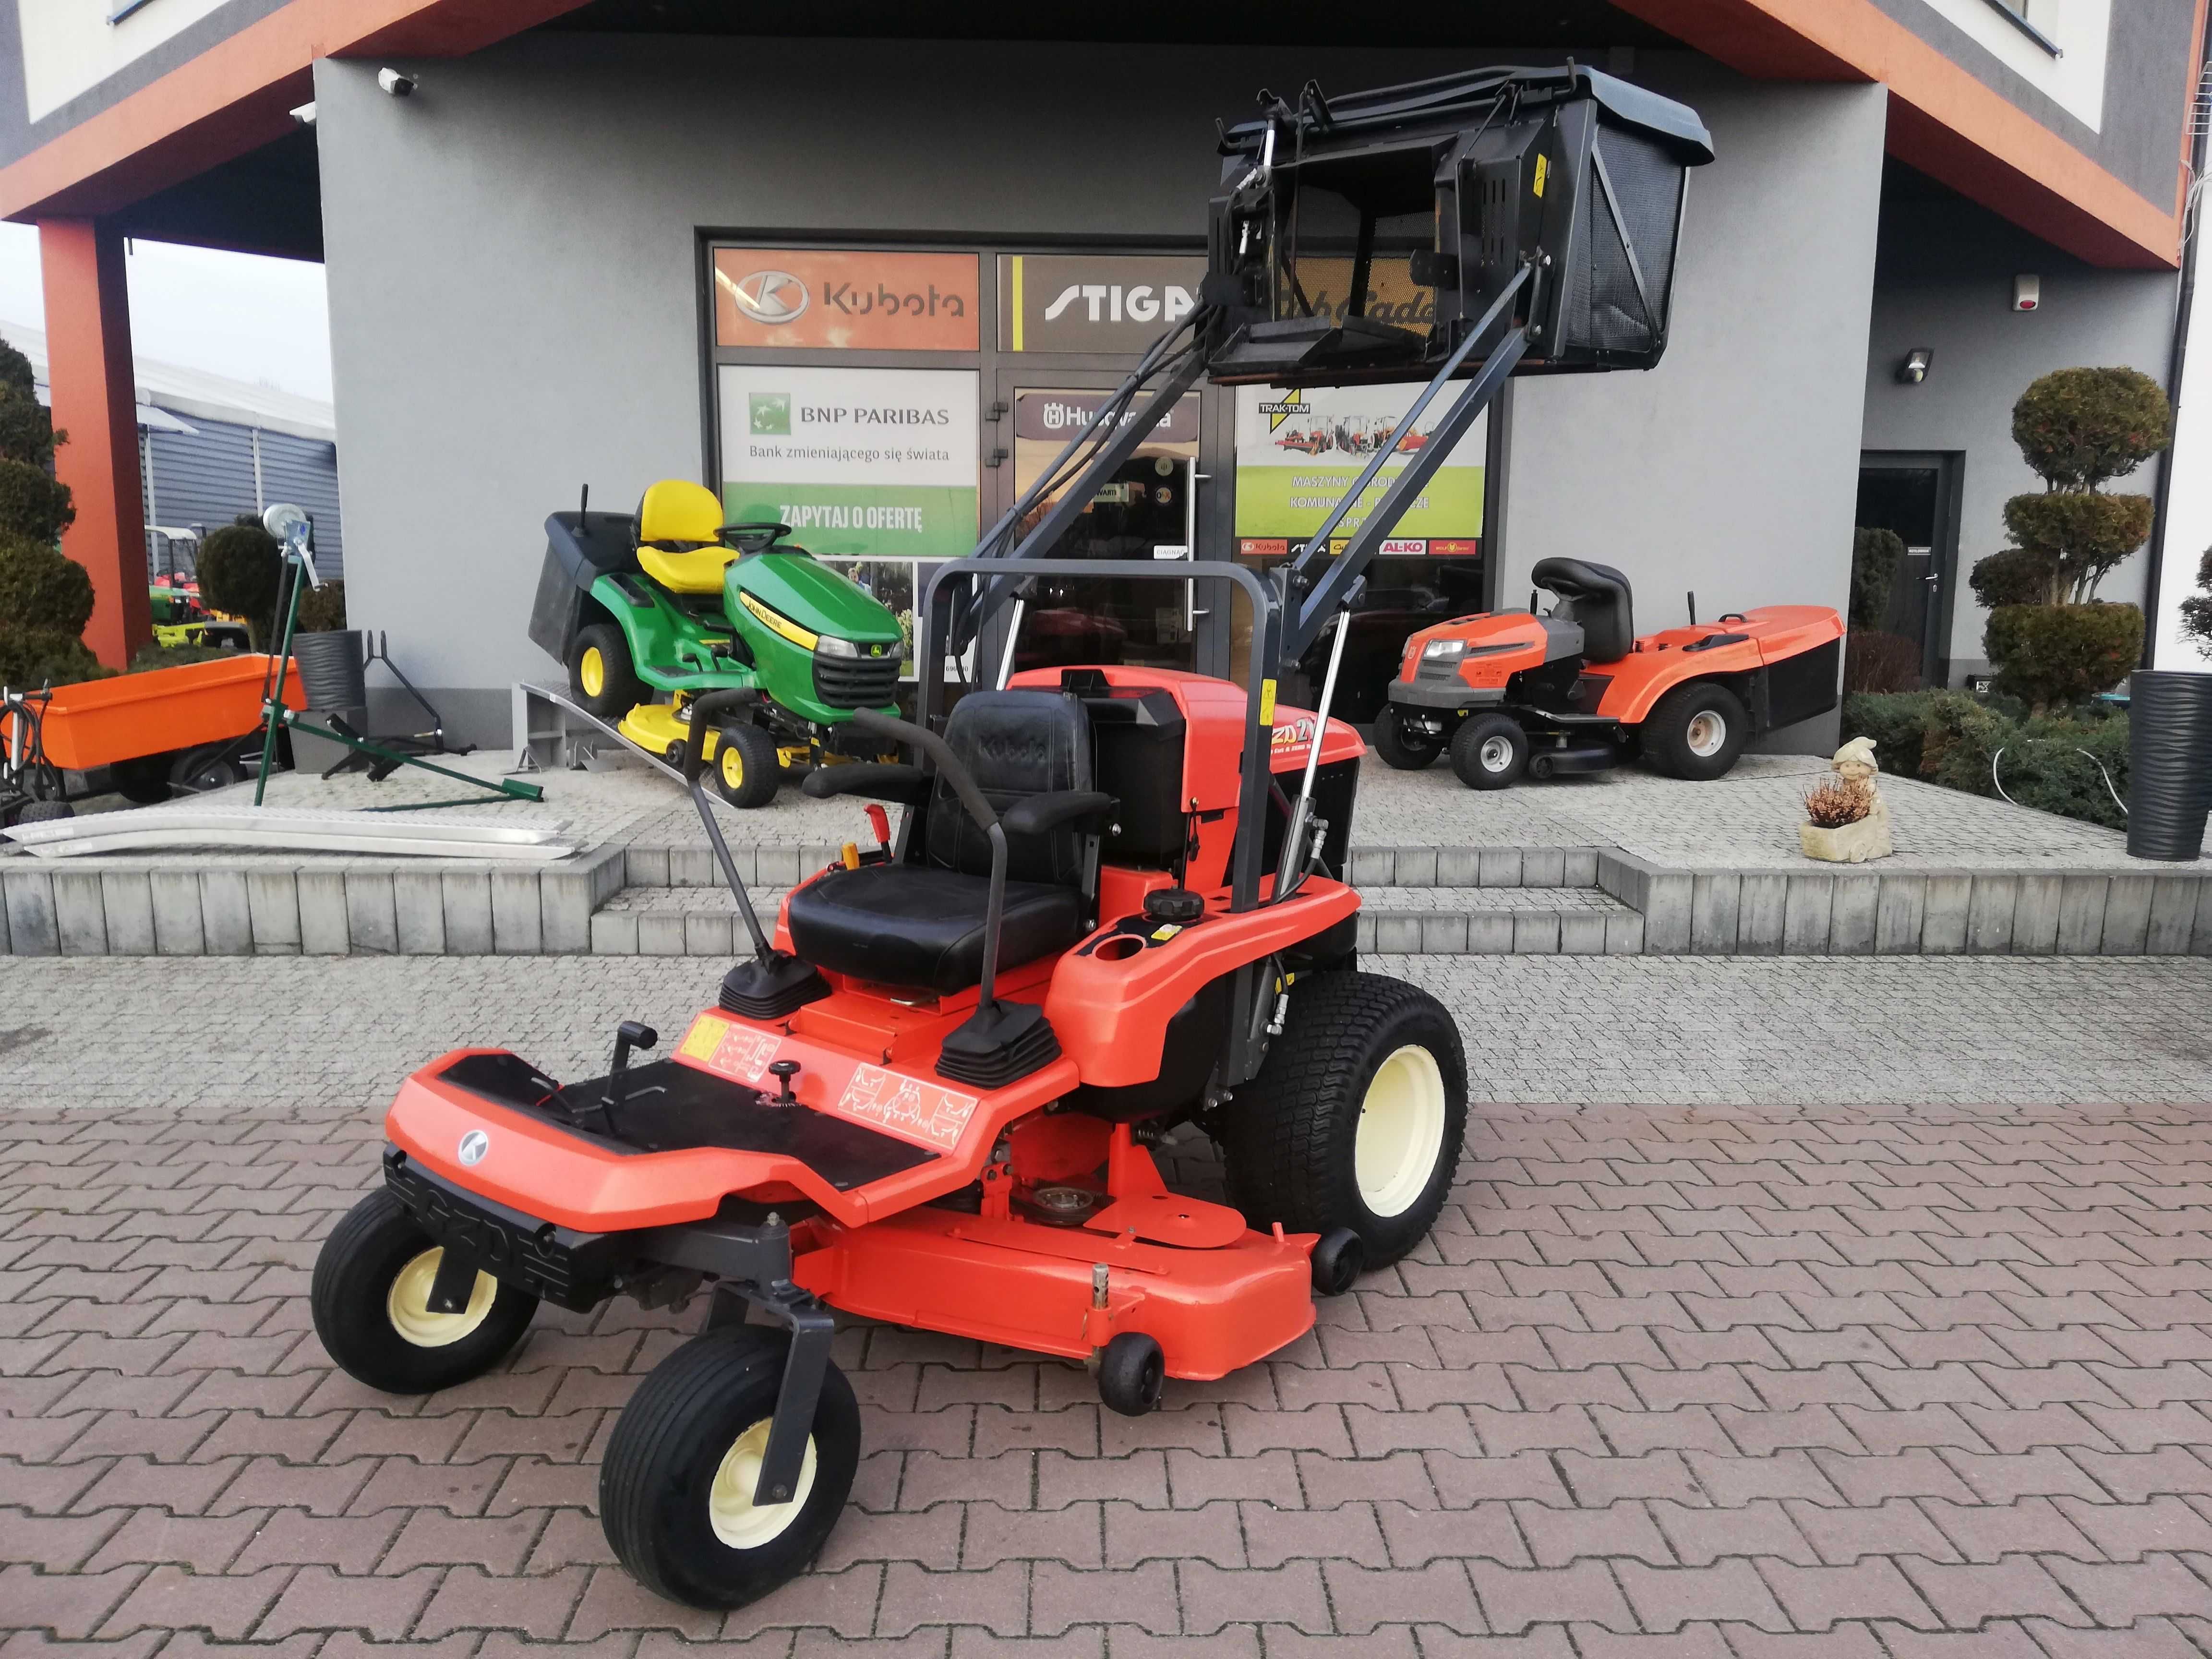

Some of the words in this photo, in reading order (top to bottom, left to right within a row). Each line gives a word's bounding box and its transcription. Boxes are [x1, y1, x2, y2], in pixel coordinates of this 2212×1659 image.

[824, 282, 964, 317] Kubota
[1045, 285, 1195, 321] STIGA
[801, 407, 847, 423] BNP
[854, 408, 950, 425] PARIBAS
[750, 445, 782, 458] Bank
[786, 446, 880, 463] zmieniającego
[884, 447, 902, 462] się
[906, 447, 950, 461] świata
[1291, 476, 1349, 488] MASZYNY
[1290, 497, 1364, 508] KOMUNANE
[780, 505, 849, 529] ZAPYTAJ
[852, 506, 863, 529] O
[866, 506, 922, 533] OFERTĘ
[1382, 542, 1423, 552] AL-KO
